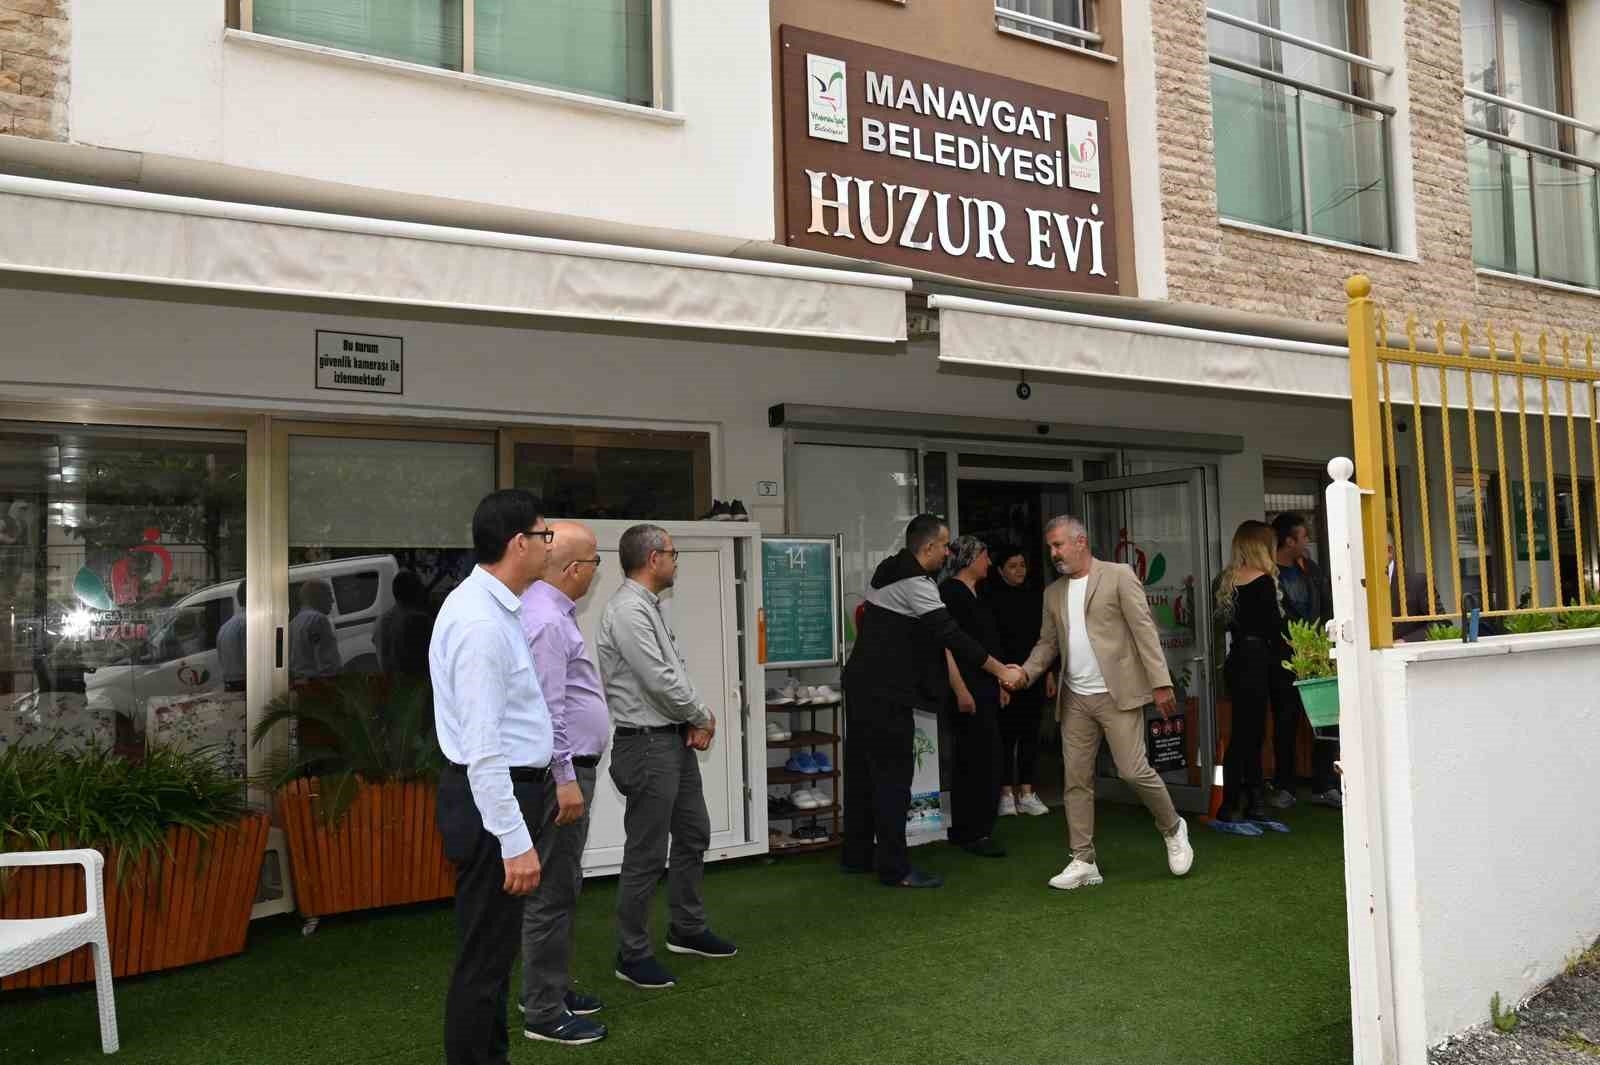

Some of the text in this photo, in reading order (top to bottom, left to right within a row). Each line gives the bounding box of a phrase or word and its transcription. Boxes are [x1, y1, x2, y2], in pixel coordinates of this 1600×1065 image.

[865, 70, 1056, 142] MANAVGAT
[861, 116, 1064, 188] BELEDİYESİ
[804, 169, 1107, 277] HUZUR EVİ
[785, 547, 806, 569] 14
